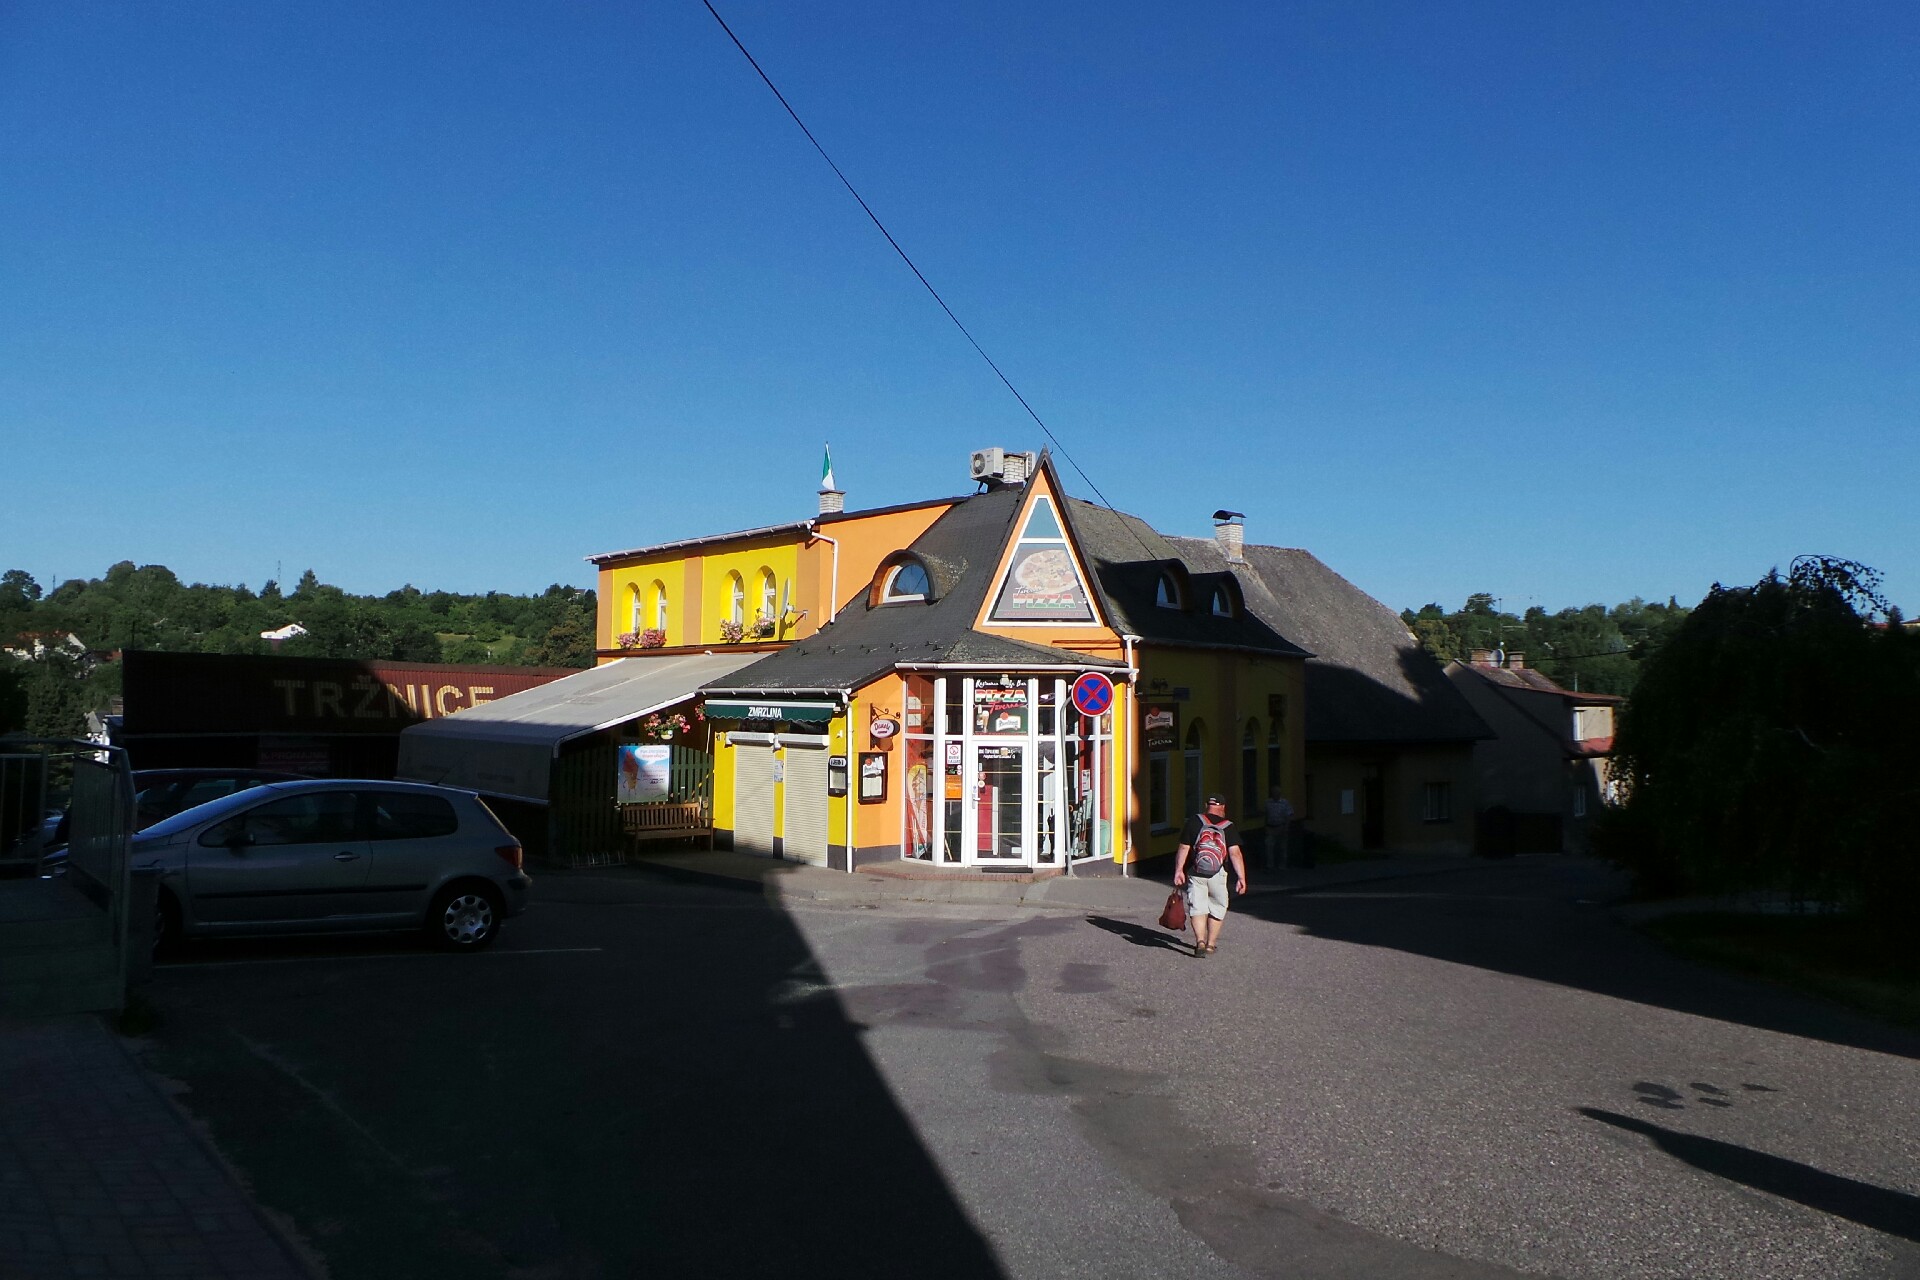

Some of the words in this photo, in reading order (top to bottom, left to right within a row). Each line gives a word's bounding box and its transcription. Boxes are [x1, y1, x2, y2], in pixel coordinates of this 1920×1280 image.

[1013, 593, 1076, 609] PIZZA
[273, 675, 495, 719] TRŽNICE
[975, 689, 1027, 703] PIZZA
[748, 706, 782, 719] ZMRZLINA
